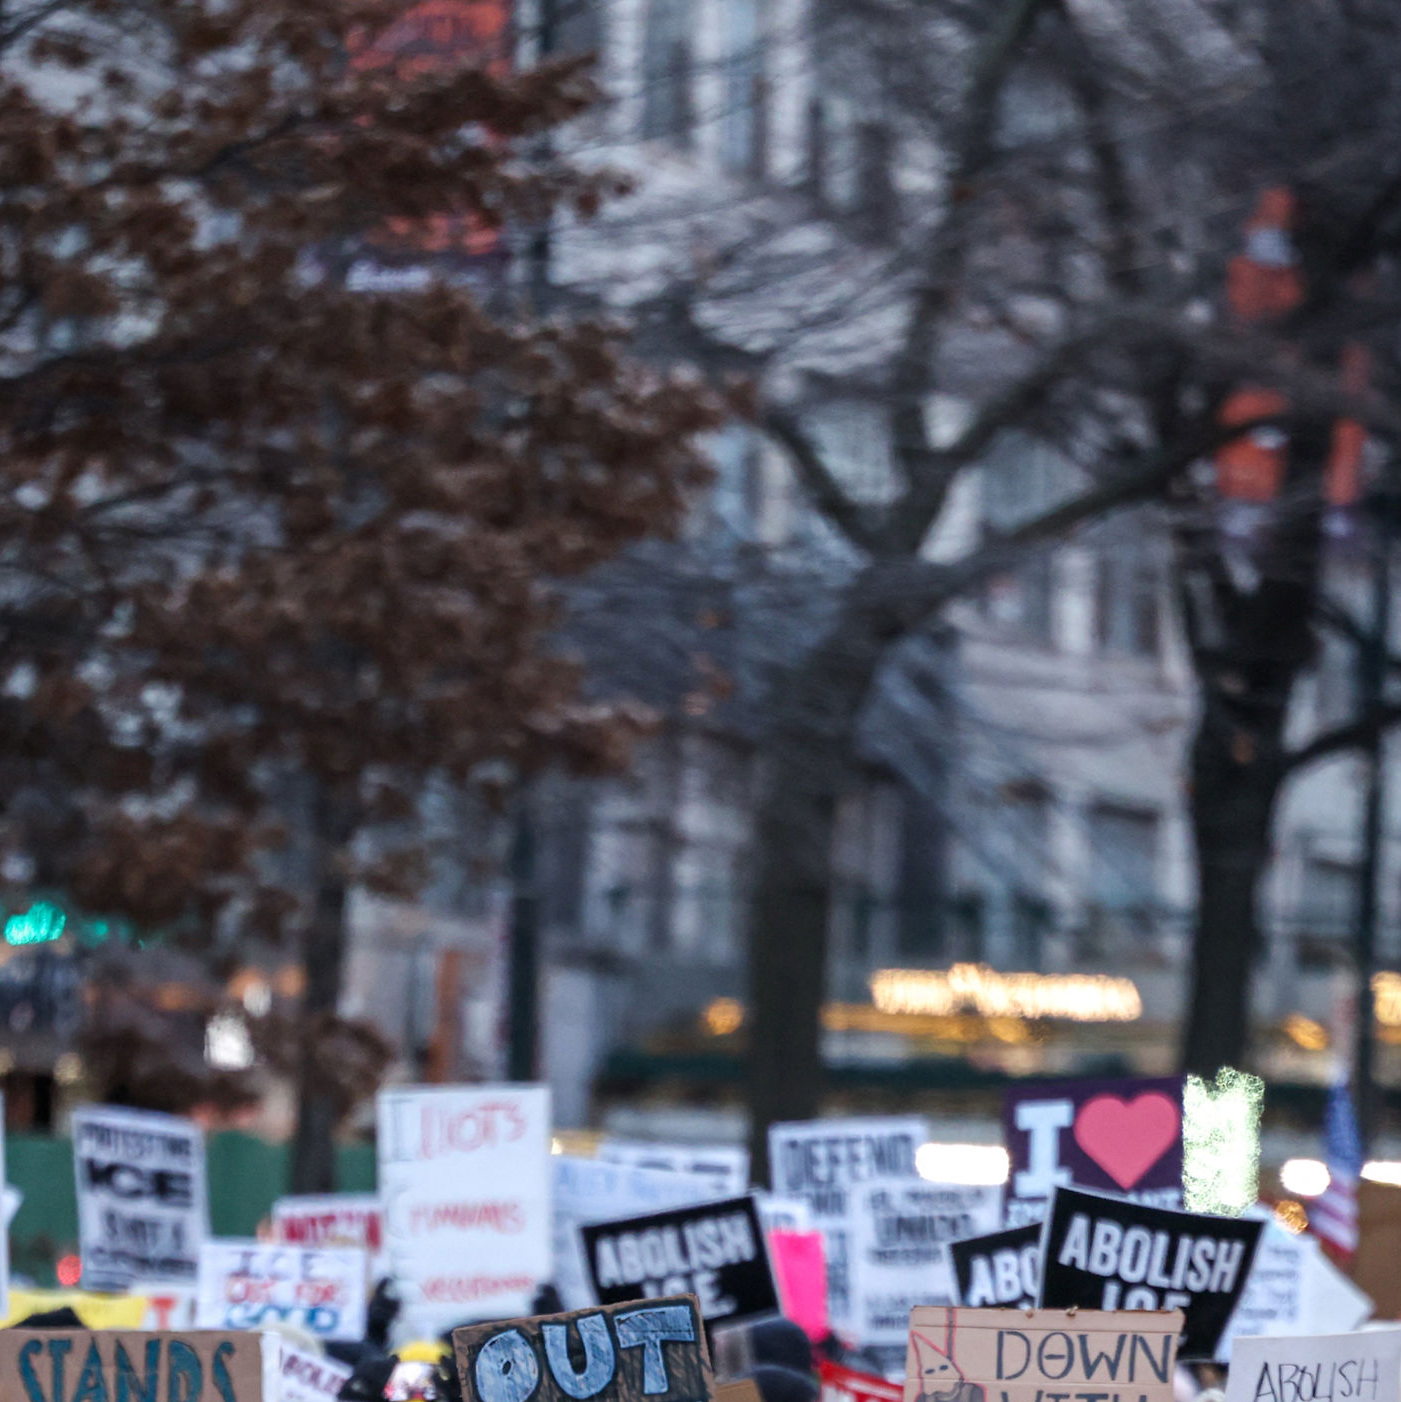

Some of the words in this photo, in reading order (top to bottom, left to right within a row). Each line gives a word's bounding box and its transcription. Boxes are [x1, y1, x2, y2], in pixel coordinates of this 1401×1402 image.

[85, 1157, 193, 1209] ICE
[1015, 1098, 1073, 1198] I
[596, 1211, 756, 1291] ABOLISH
[1057, 1212, 1247, 1294] ABOLISH
[996, 1329, 1173, 1384] DOWN
